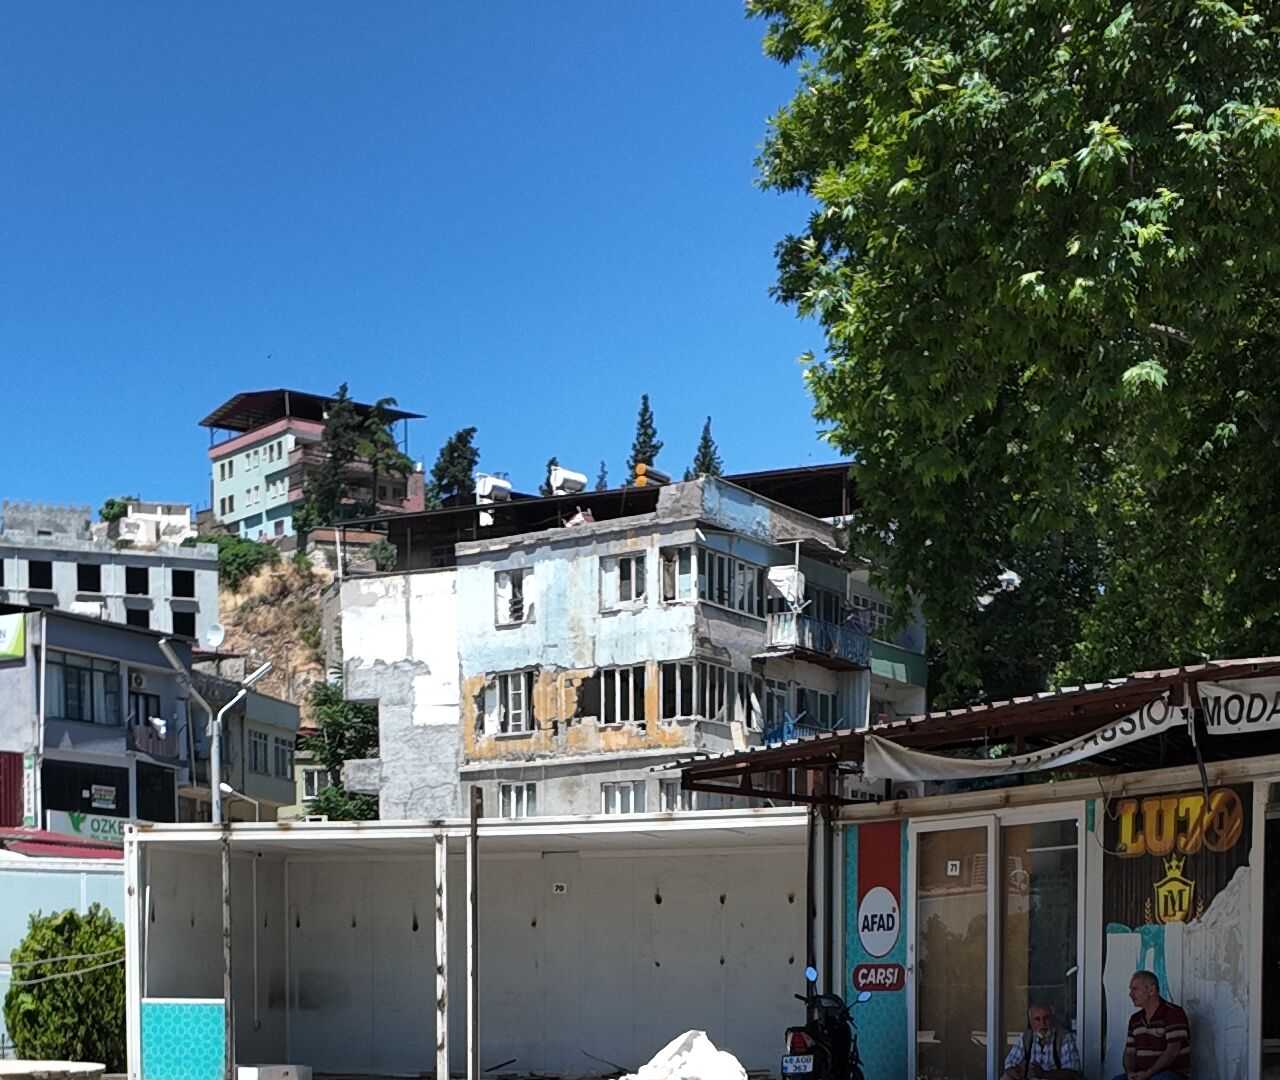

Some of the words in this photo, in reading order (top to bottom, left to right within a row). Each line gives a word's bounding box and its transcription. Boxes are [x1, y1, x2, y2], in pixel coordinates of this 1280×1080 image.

[1116, 788, 1244, 858] LUJO
[861, 912, 896, 933] AFAD
[857, 968, 898, 988] ÇARŞI
